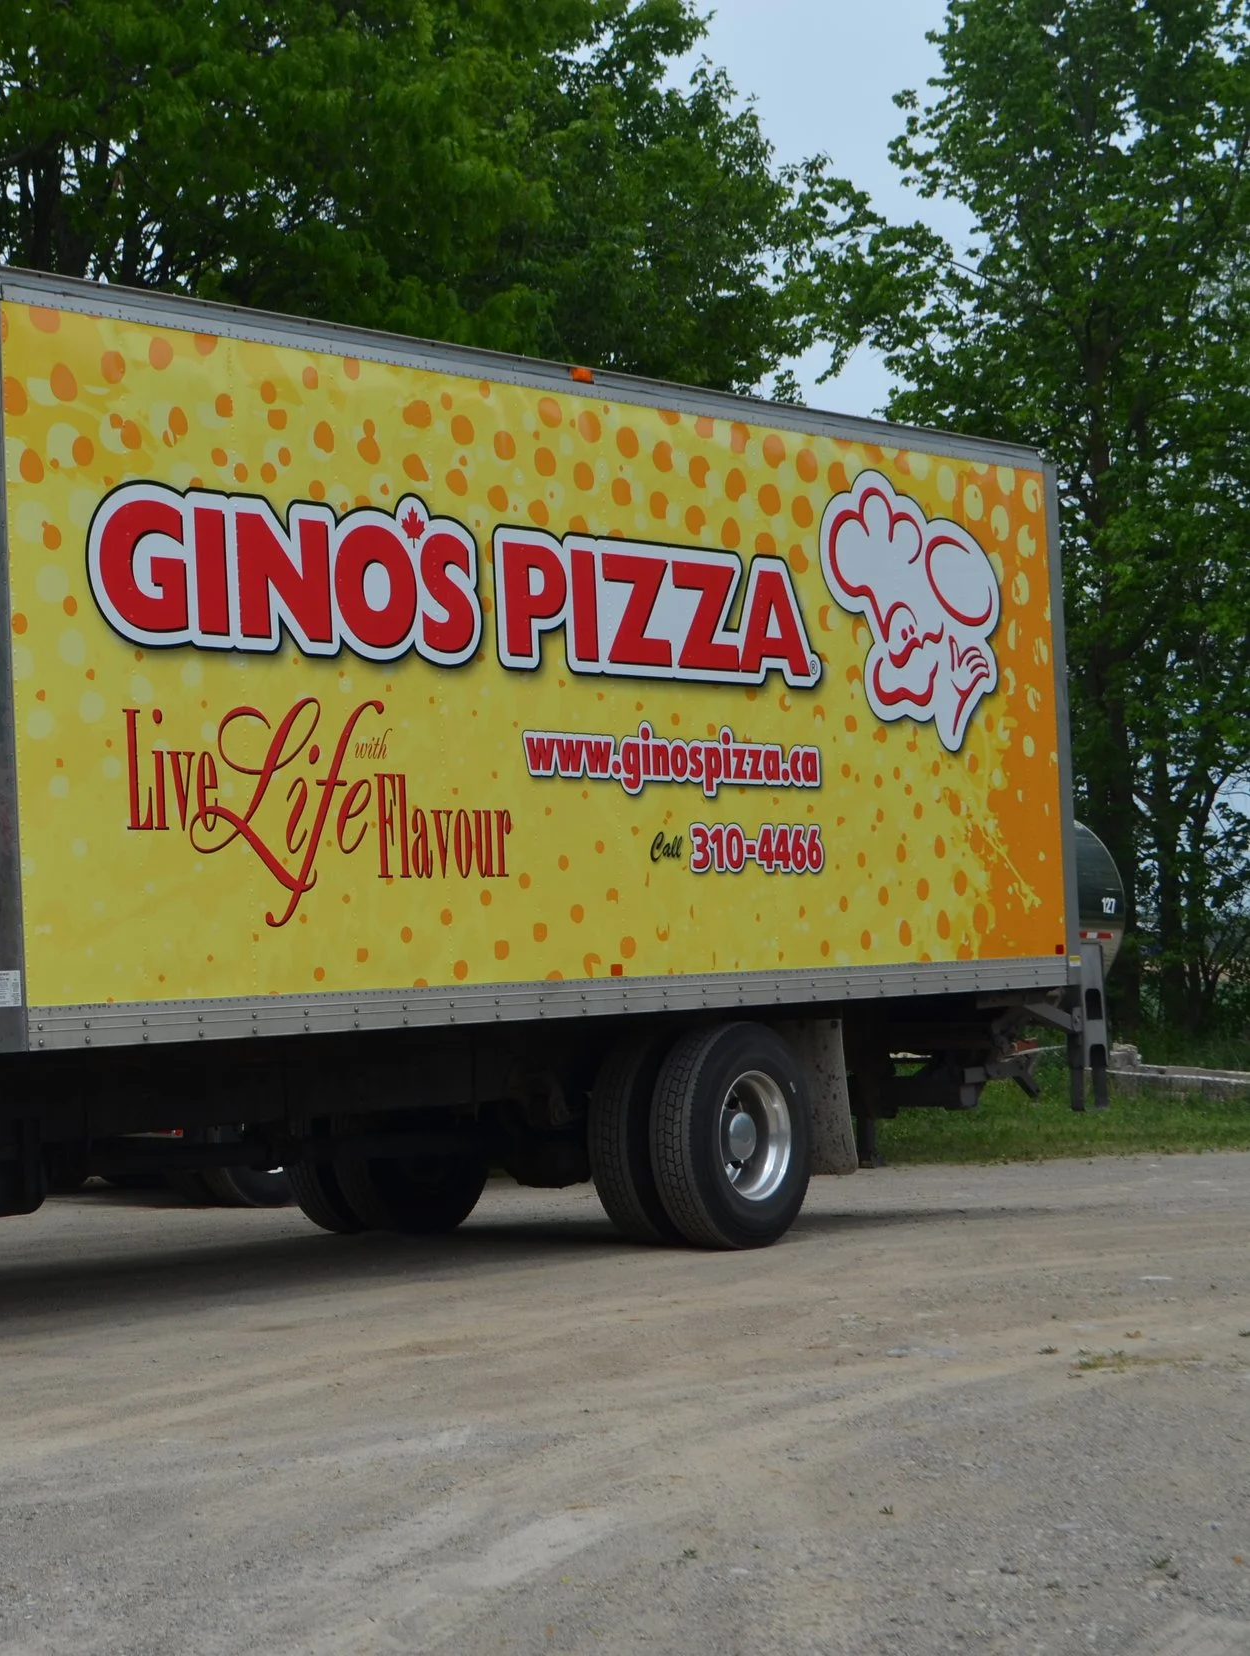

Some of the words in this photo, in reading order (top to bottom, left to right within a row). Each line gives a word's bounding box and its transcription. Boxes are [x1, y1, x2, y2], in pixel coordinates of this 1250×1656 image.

[98, 498, 475, 653] GINO'S
[501, 540, 812, 678] PIZZA
[122, 707, 219, 832] Live
[354, 727, 393, 760] with
[524, 726, 820, 792] www.ginospizza.ca
[189, 696, 385, 928] Life
[373, 773, 512, 880] Flavour
[649, 831, 684, 863] Call
[691, 823, 823, 871] 310-4466
[1101, 896, 1117, 914] 127
